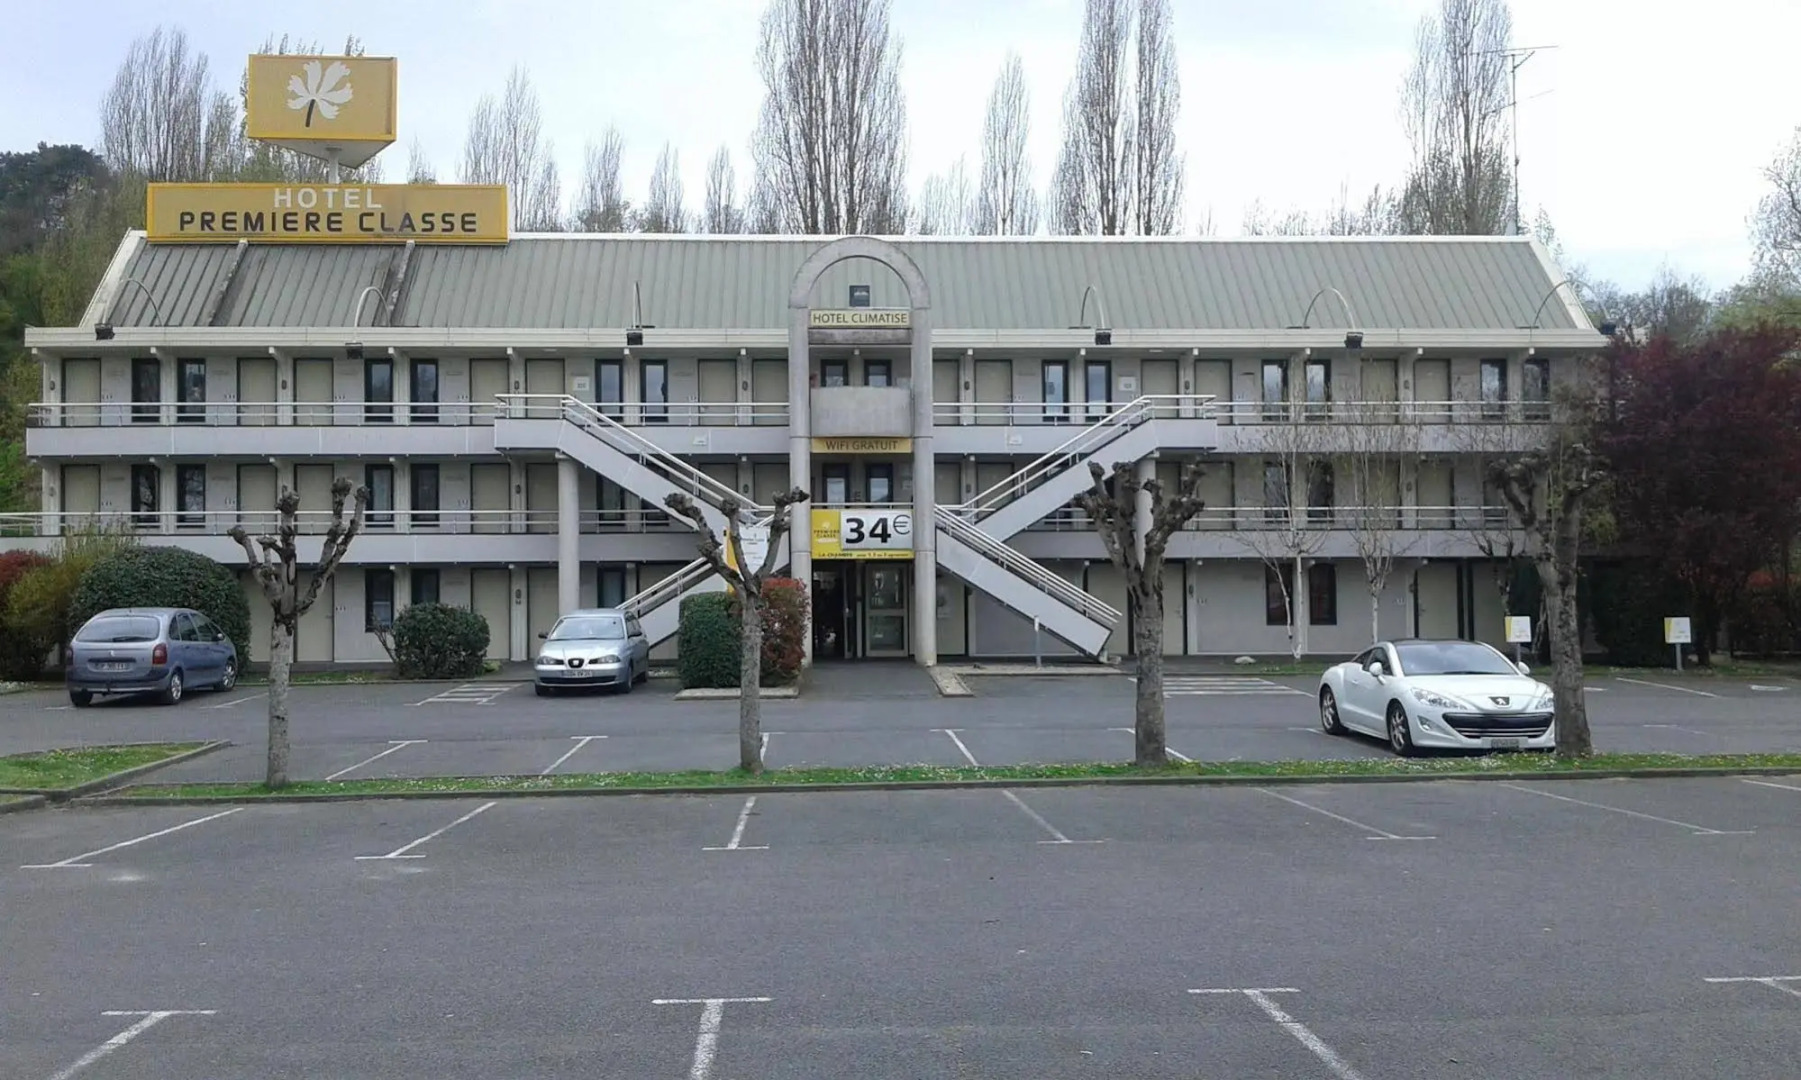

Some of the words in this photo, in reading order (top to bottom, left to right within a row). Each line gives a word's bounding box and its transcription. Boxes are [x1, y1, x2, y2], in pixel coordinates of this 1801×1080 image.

[273, 187, 382, 209] HOTEL
[179, 211, 344, 233] PREMIERE
[358, 211, 477, 233] CLASSE
[813, 313, 848, 323] HOTEL
[851, 313, 907, 323] CLIMATISE
[825, 440, 849, 450] WIFI
[852, 440, 898, 450] GRATUIT
[845, 514, 911, 544] 34€
